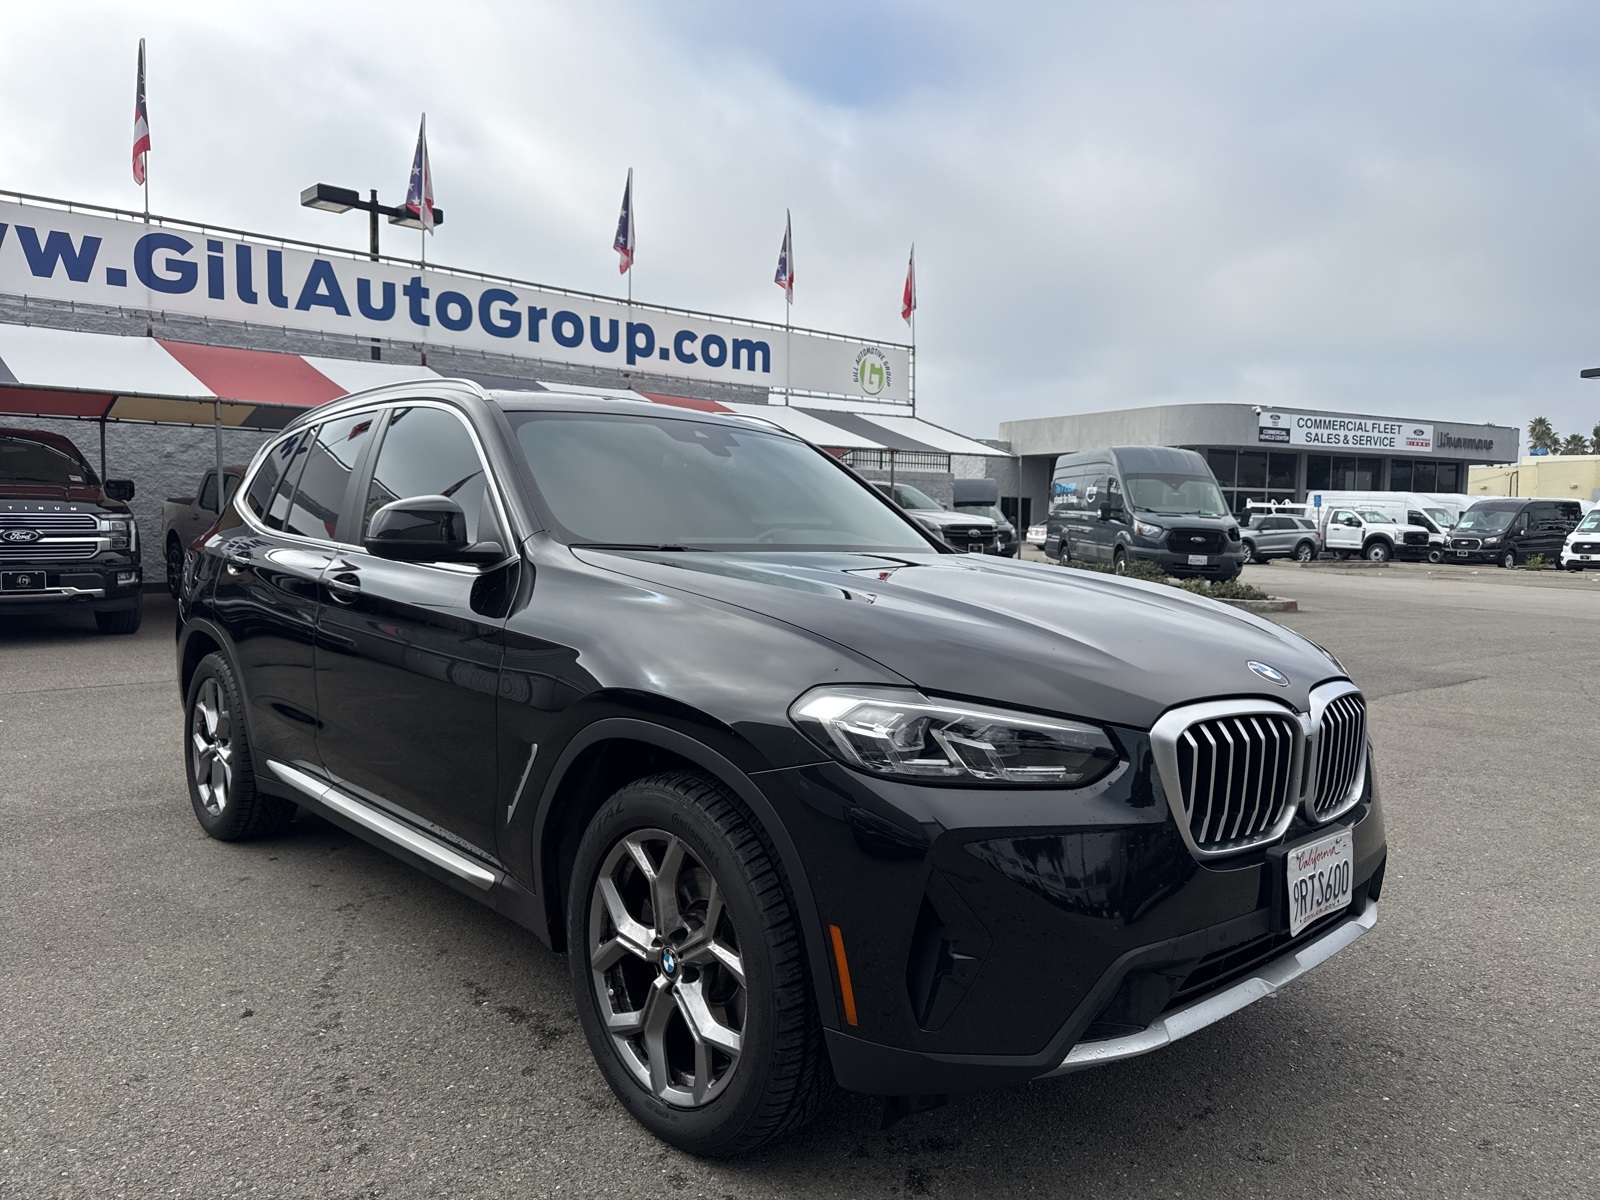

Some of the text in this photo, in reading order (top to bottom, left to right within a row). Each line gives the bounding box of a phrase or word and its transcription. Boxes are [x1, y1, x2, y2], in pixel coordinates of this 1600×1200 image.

[0, 223, 771, 374] w.GillAutoGroup.com
[855, 347, 886, 367] AUTOMOTIVE
[883, 360, 892, 388] GROUP
[1297, 417, 1403, 435] COMMERCIAL FLEET
[1305, 432, 1396, 447] SALES & SERVICE
[1436, 431, 1494, 451] Livermore
[9, 531, 32, 540] Ford
[1297, 845, 1341, 871] California
[1293, 859, 1350, 922] 9RTS600
